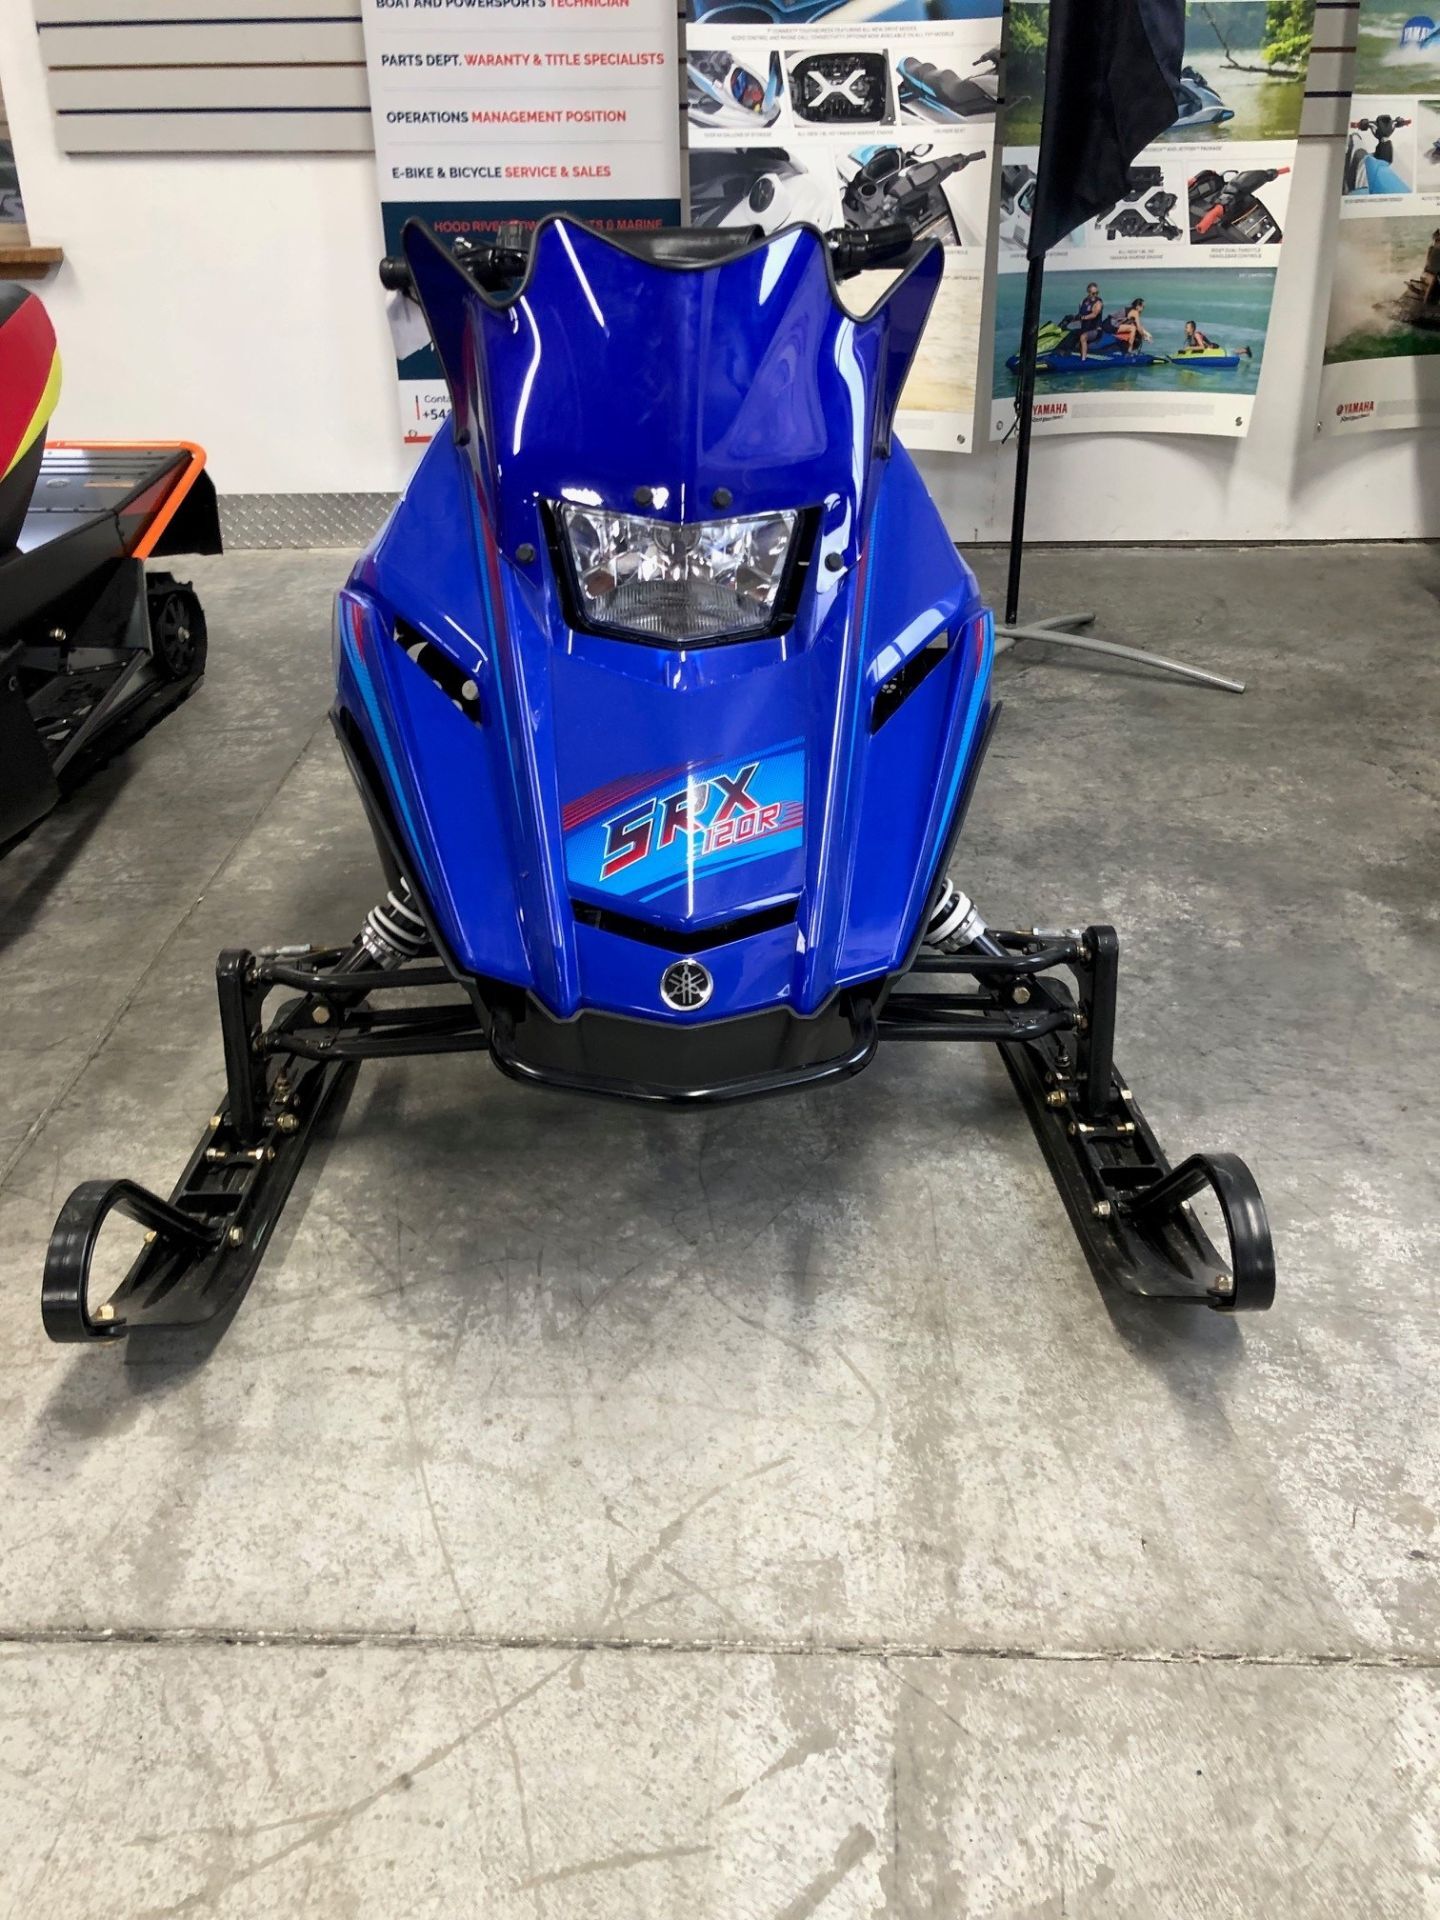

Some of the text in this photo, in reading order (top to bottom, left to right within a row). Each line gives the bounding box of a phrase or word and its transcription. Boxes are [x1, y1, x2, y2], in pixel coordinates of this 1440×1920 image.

[376, 0, 409, 8] BOAT
[414, 0, 441, 8] AND
[446, 0, 546, 8] POWERSPORTS
[381, 52, 665, 67] PARTS DEPT. WARANTY & TITLE SPECIALISTS
[386, 109, 627, 124] OPERATIONS MANAGEMENT POSITION
[391, 165, 611, 179] E-BIKE & BICYCLE SERVICE & SALES
[434, 221, 470, 233] HOOD
[472, 220, 504, 232] RIVE
[1033, 403, 1068, 415] YAMAHA
[1344, 401, 1375, 413] YAMAHA
[600, 762, 760, 881] SRX
[701, 803, 781, 856] 120R
